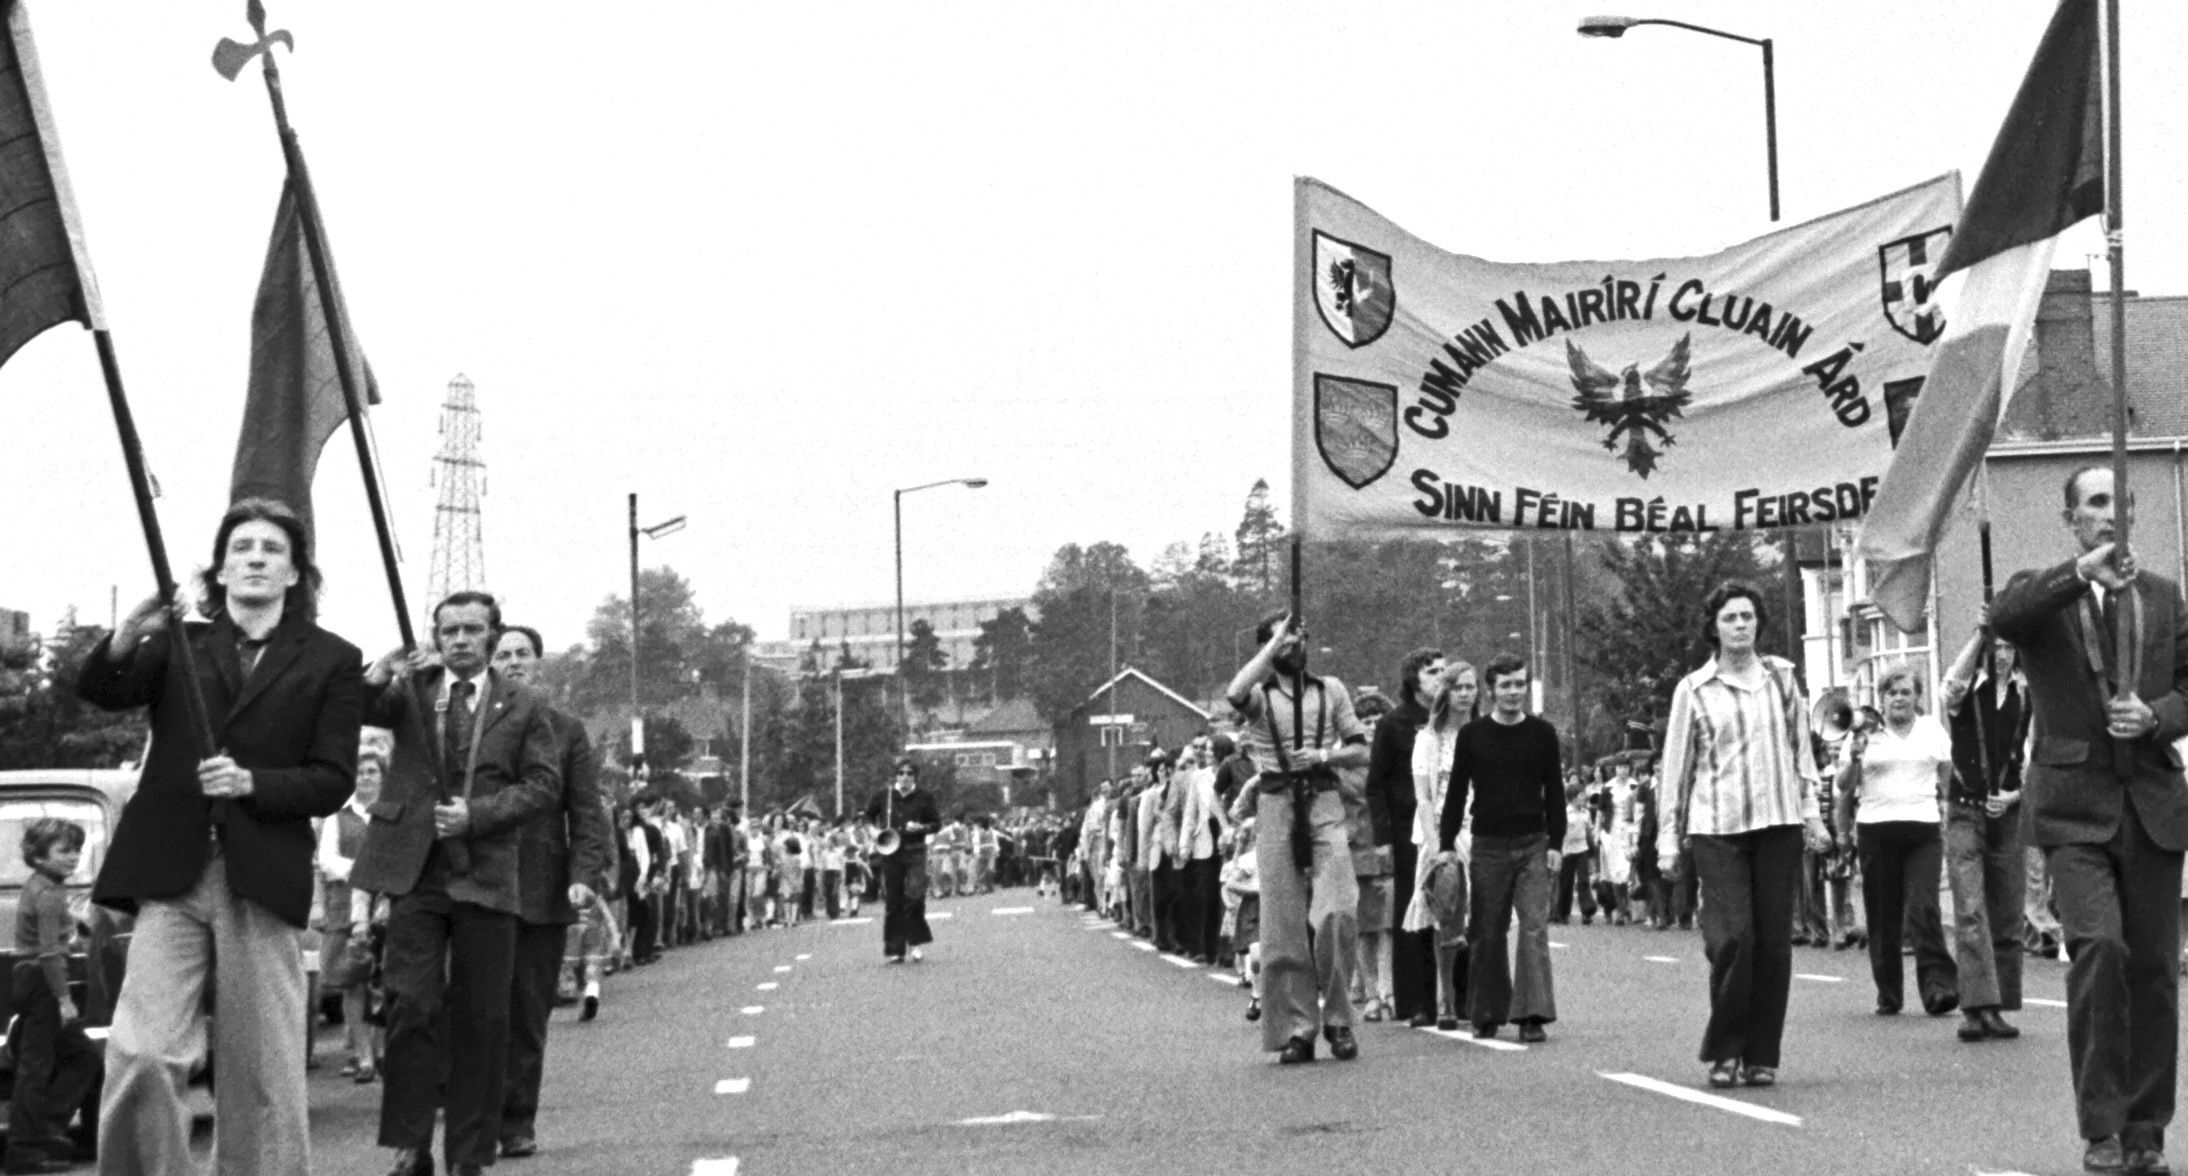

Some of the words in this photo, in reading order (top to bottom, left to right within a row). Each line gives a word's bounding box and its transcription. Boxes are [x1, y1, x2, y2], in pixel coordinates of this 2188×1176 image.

[1404, 318, 1511, 440] CUMANN
[1495, 272, 1666, 347] MAIRÍRÍ
[1669, 278, 1814, 359] CLUAIN
[1802, 342, 1871, 428] ÁRD
[1411, 468, 1501, 523] SINN
[1514, 486, 1595, 531] FÉIN
[1615, 496, 1719, 532] BÉAL
